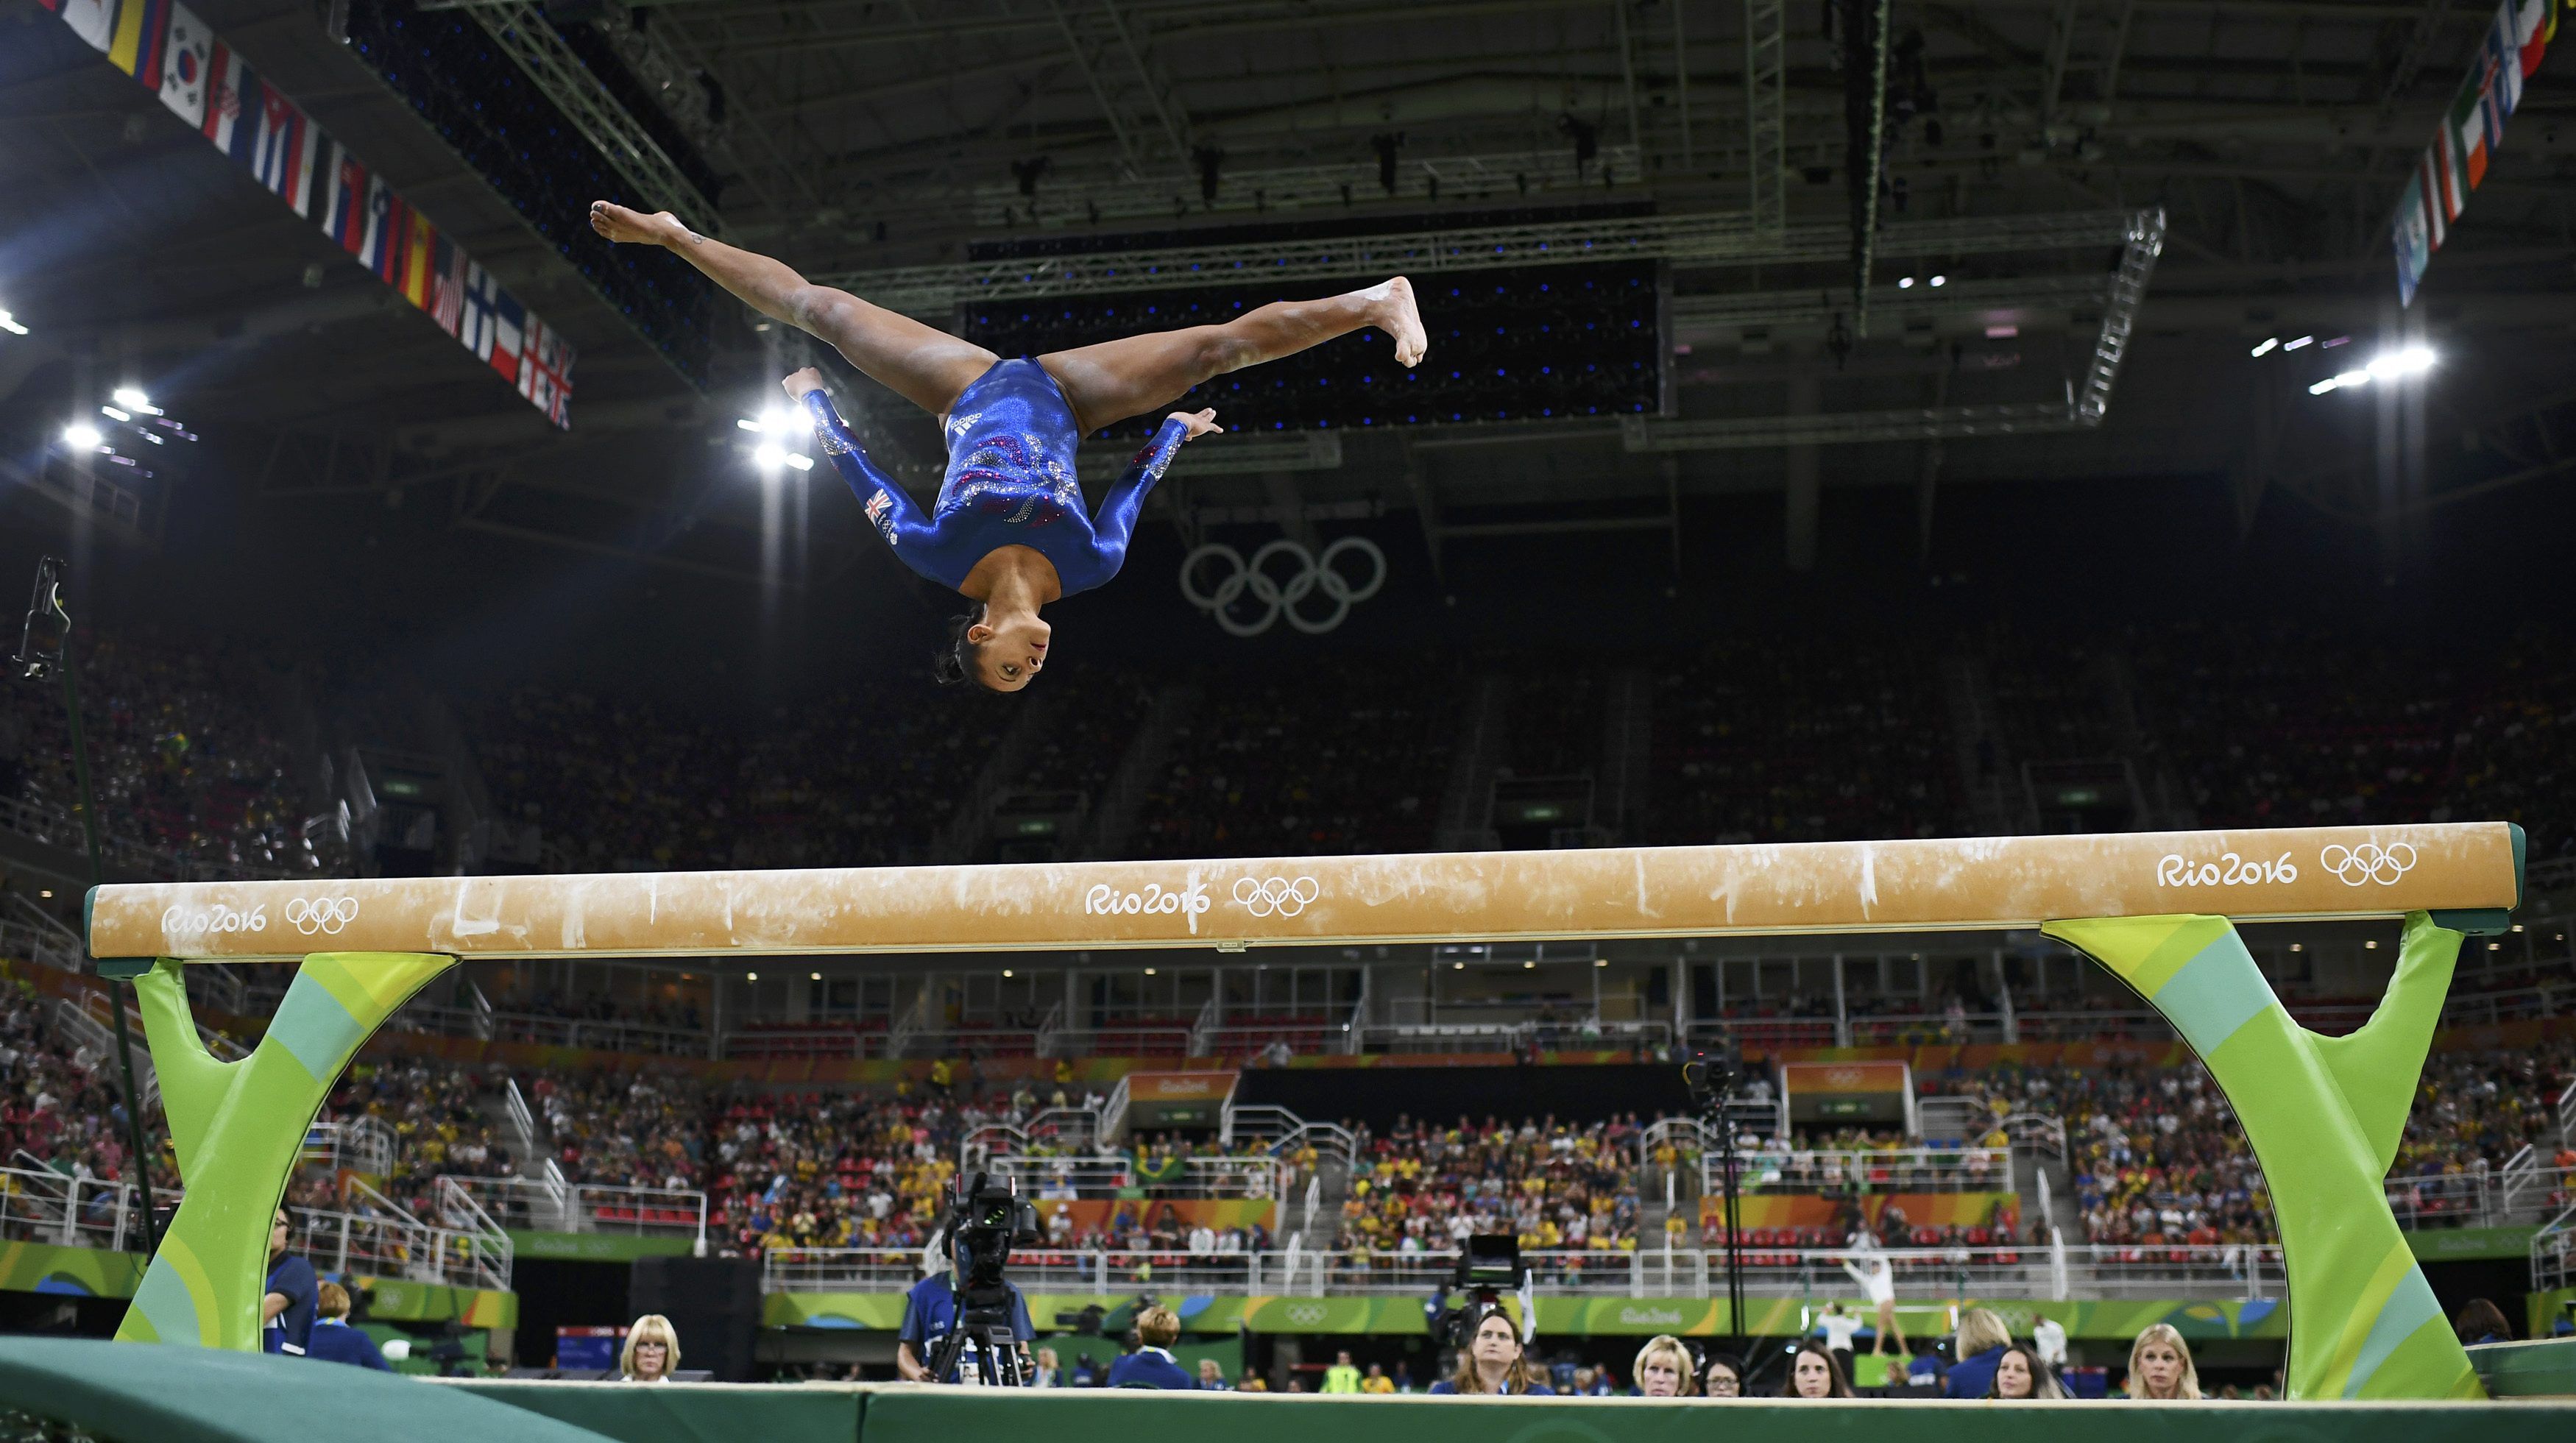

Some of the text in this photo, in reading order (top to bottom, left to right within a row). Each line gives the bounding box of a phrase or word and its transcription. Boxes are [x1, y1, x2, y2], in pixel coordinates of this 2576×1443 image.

[950, 413, 982, 431] adidas
[2157, 851, 2298, 887] Rio2016
[1086, 883, 1211, 915] Rio2016
[161, 902, 266, 933] Rio2016
